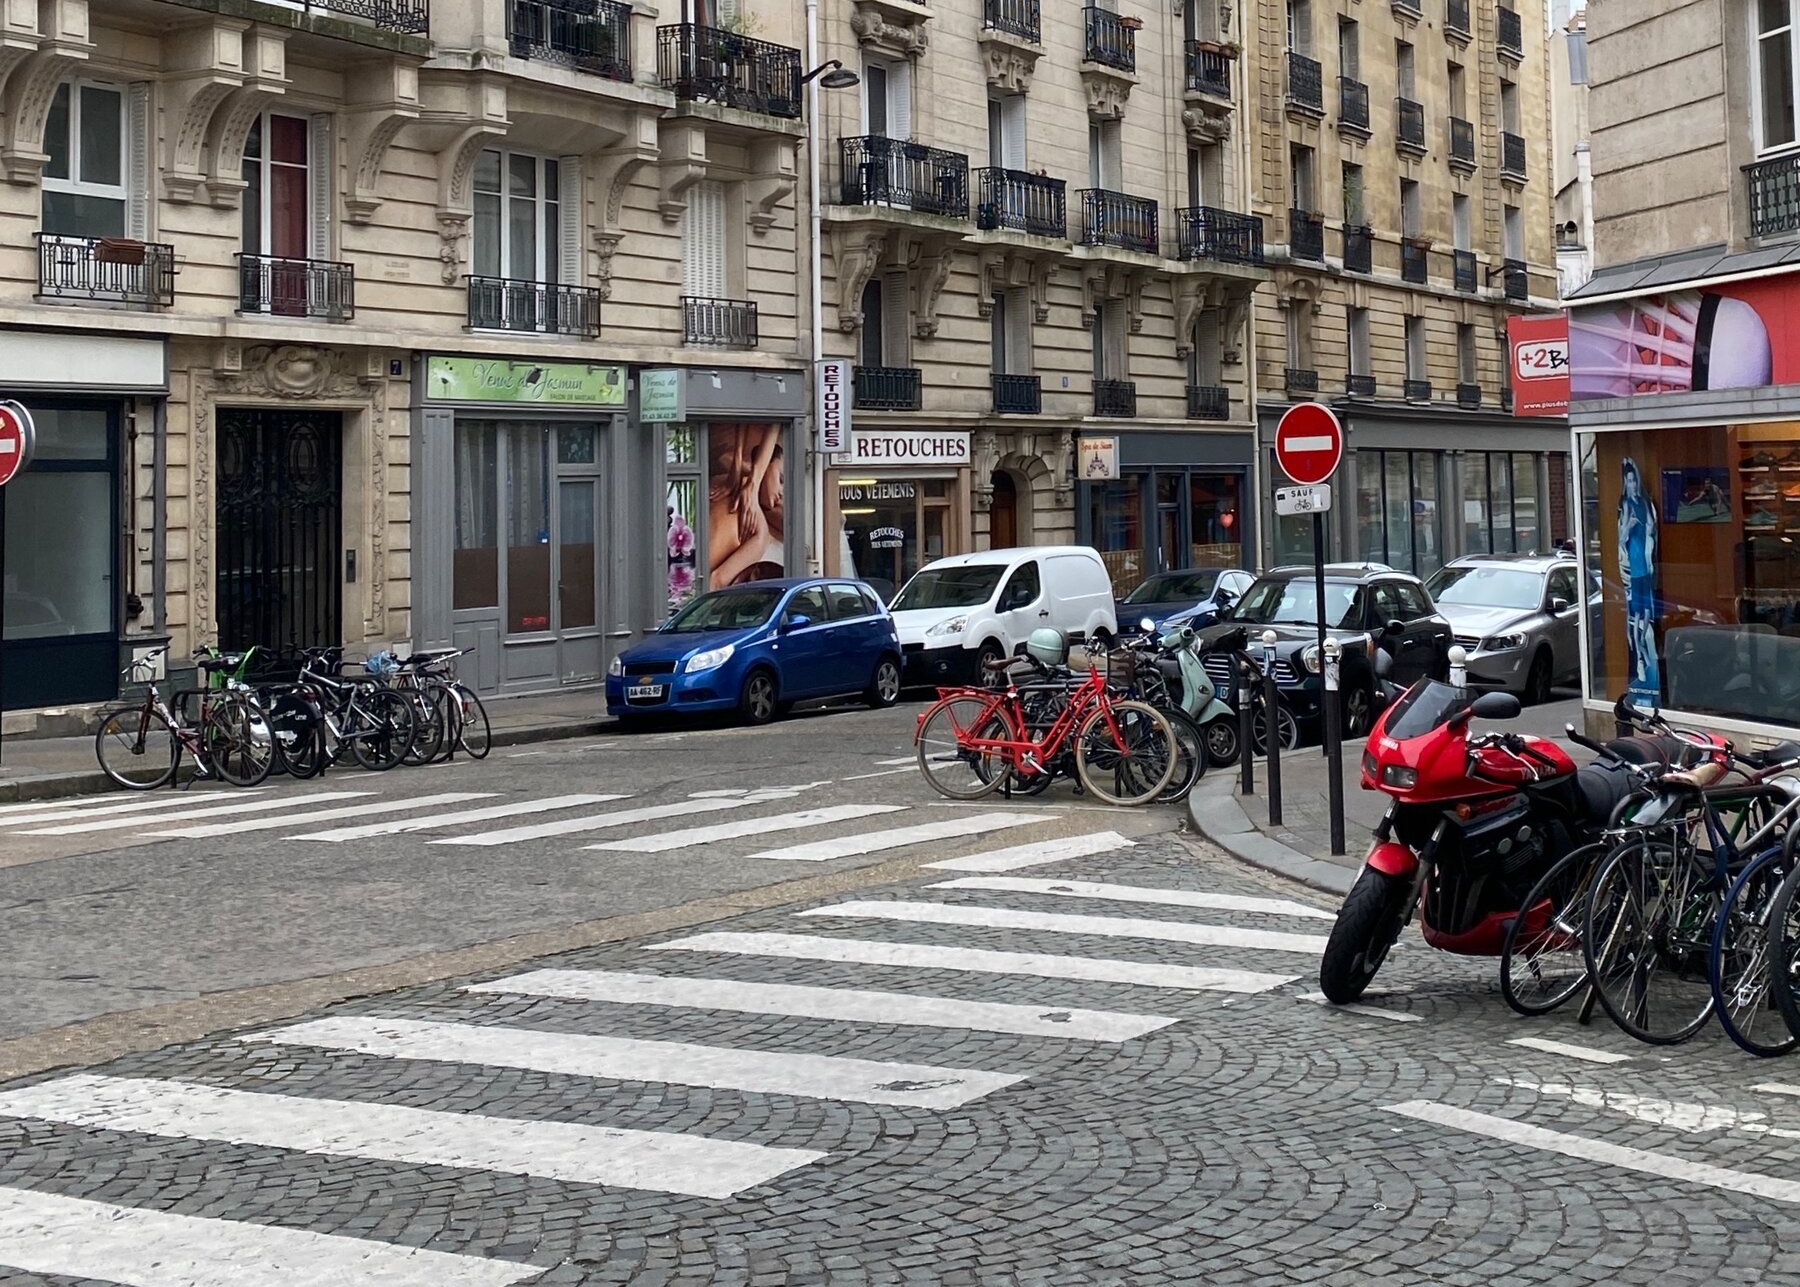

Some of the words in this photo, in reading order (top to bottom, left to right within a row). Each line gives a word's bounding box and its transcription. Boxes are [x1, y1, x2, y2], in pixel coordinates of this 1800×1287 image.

[392, 361, 400, 374] 7
[824, 365, 839, 447] RETOUCHES
[857, 438, 966, 458] RETOUCHES
[866, 483, 915, 500] VETEMENTS
[1291, 488, 1313, 498] SAUF
[869, 527, 904, 541] RETOUCHES
